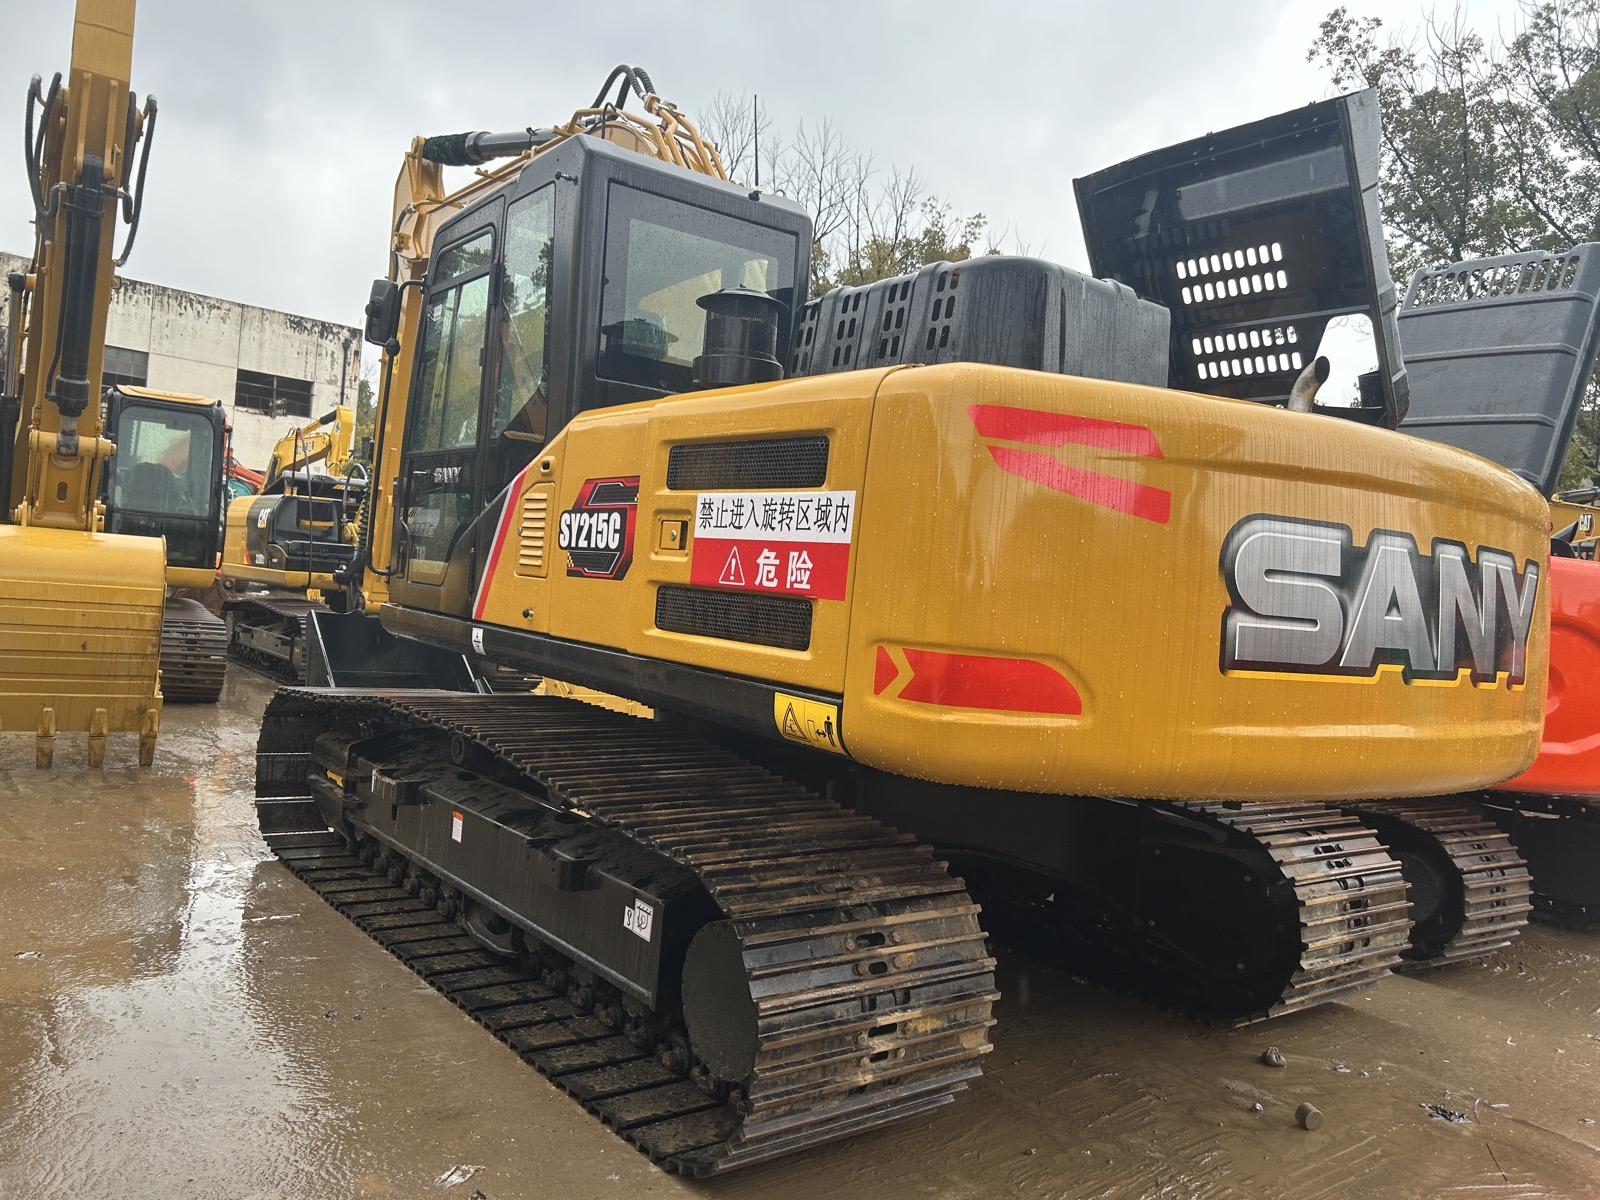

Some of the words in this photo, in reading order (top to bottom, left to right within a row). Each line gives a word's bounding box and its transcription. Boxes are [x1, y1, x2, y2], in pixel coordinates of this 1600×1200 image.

[257, 508, 271, 528] CAT
[559, 511, 621, 550] SY215C
[699, 497, 850, 534] 禁止进入旋转区域内
[1579, 513, 1592, 531] CAT
[754, 547, 814, 590] 危险
[1233, 525, 1539, 679] SANY
